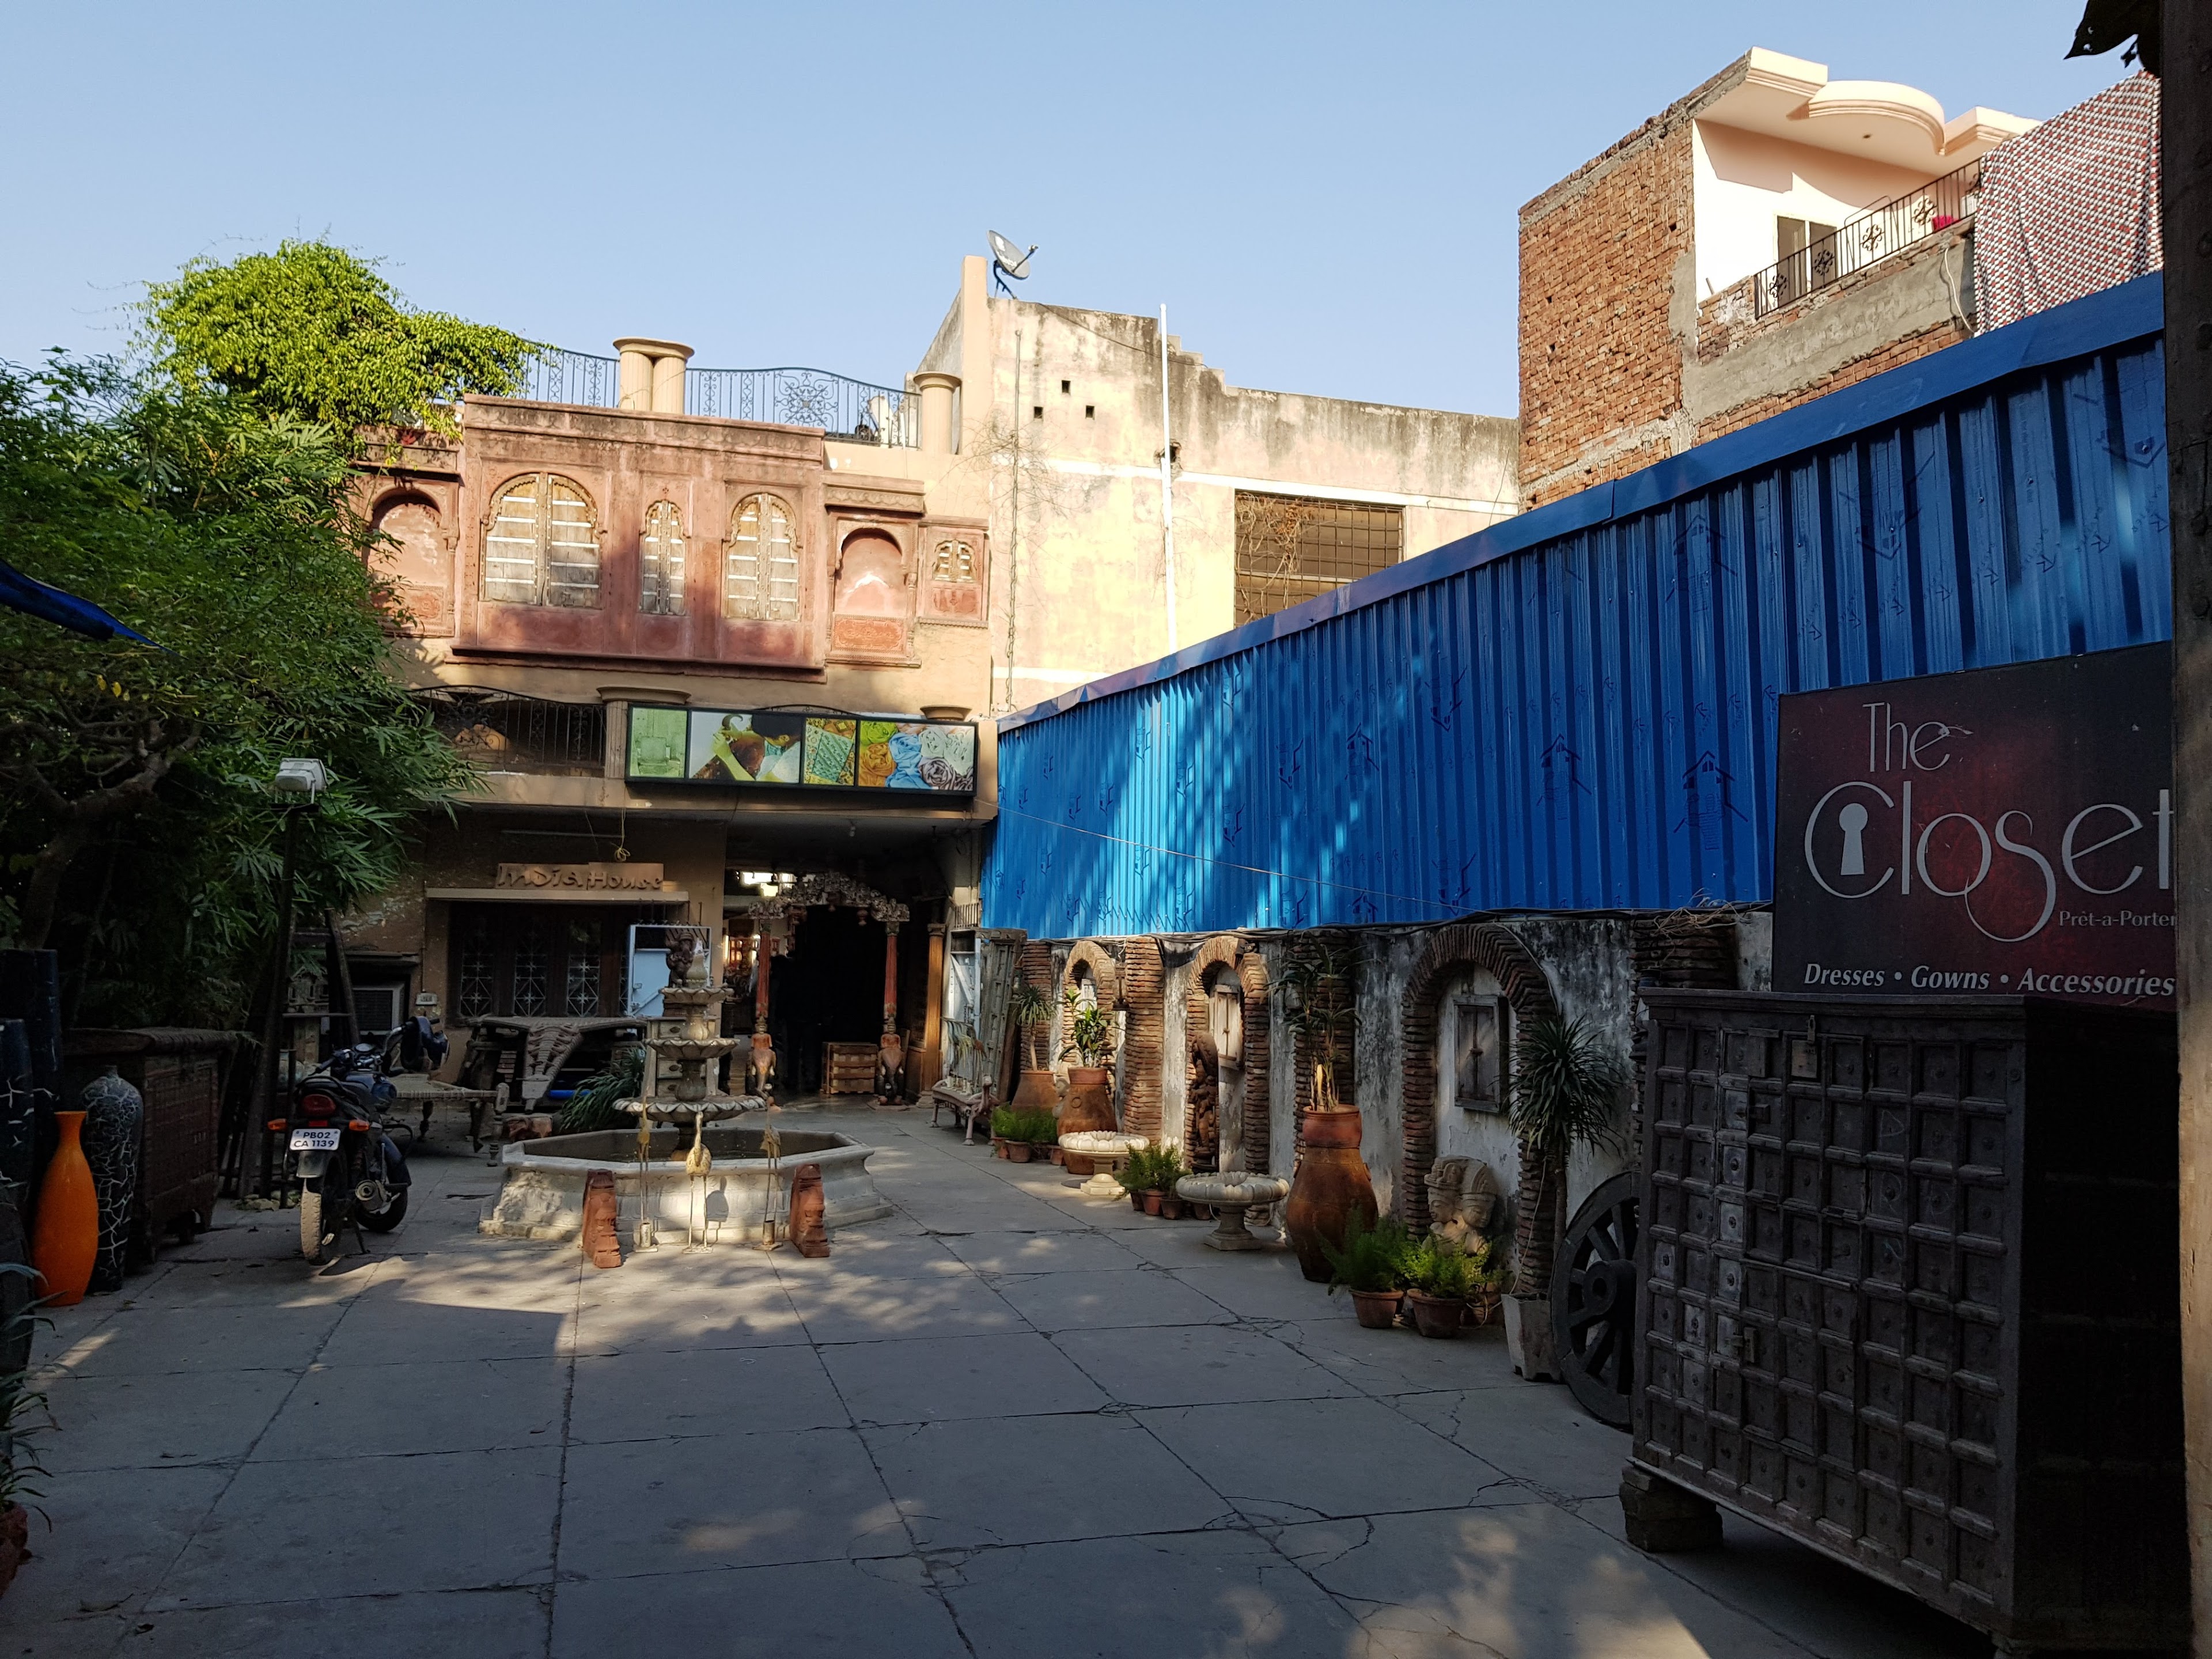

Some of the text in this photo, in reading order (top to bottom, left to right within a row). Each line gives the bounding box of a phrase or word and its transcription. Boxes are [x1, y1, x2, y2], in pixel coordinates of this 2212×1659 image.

[1862, 702, 1970, 772] The
[588, 870, 663, 889] House
[1804, 781, 2175, 943] Closet
[1804, 963, 2176, 996] Dresses Gowns Accessories
